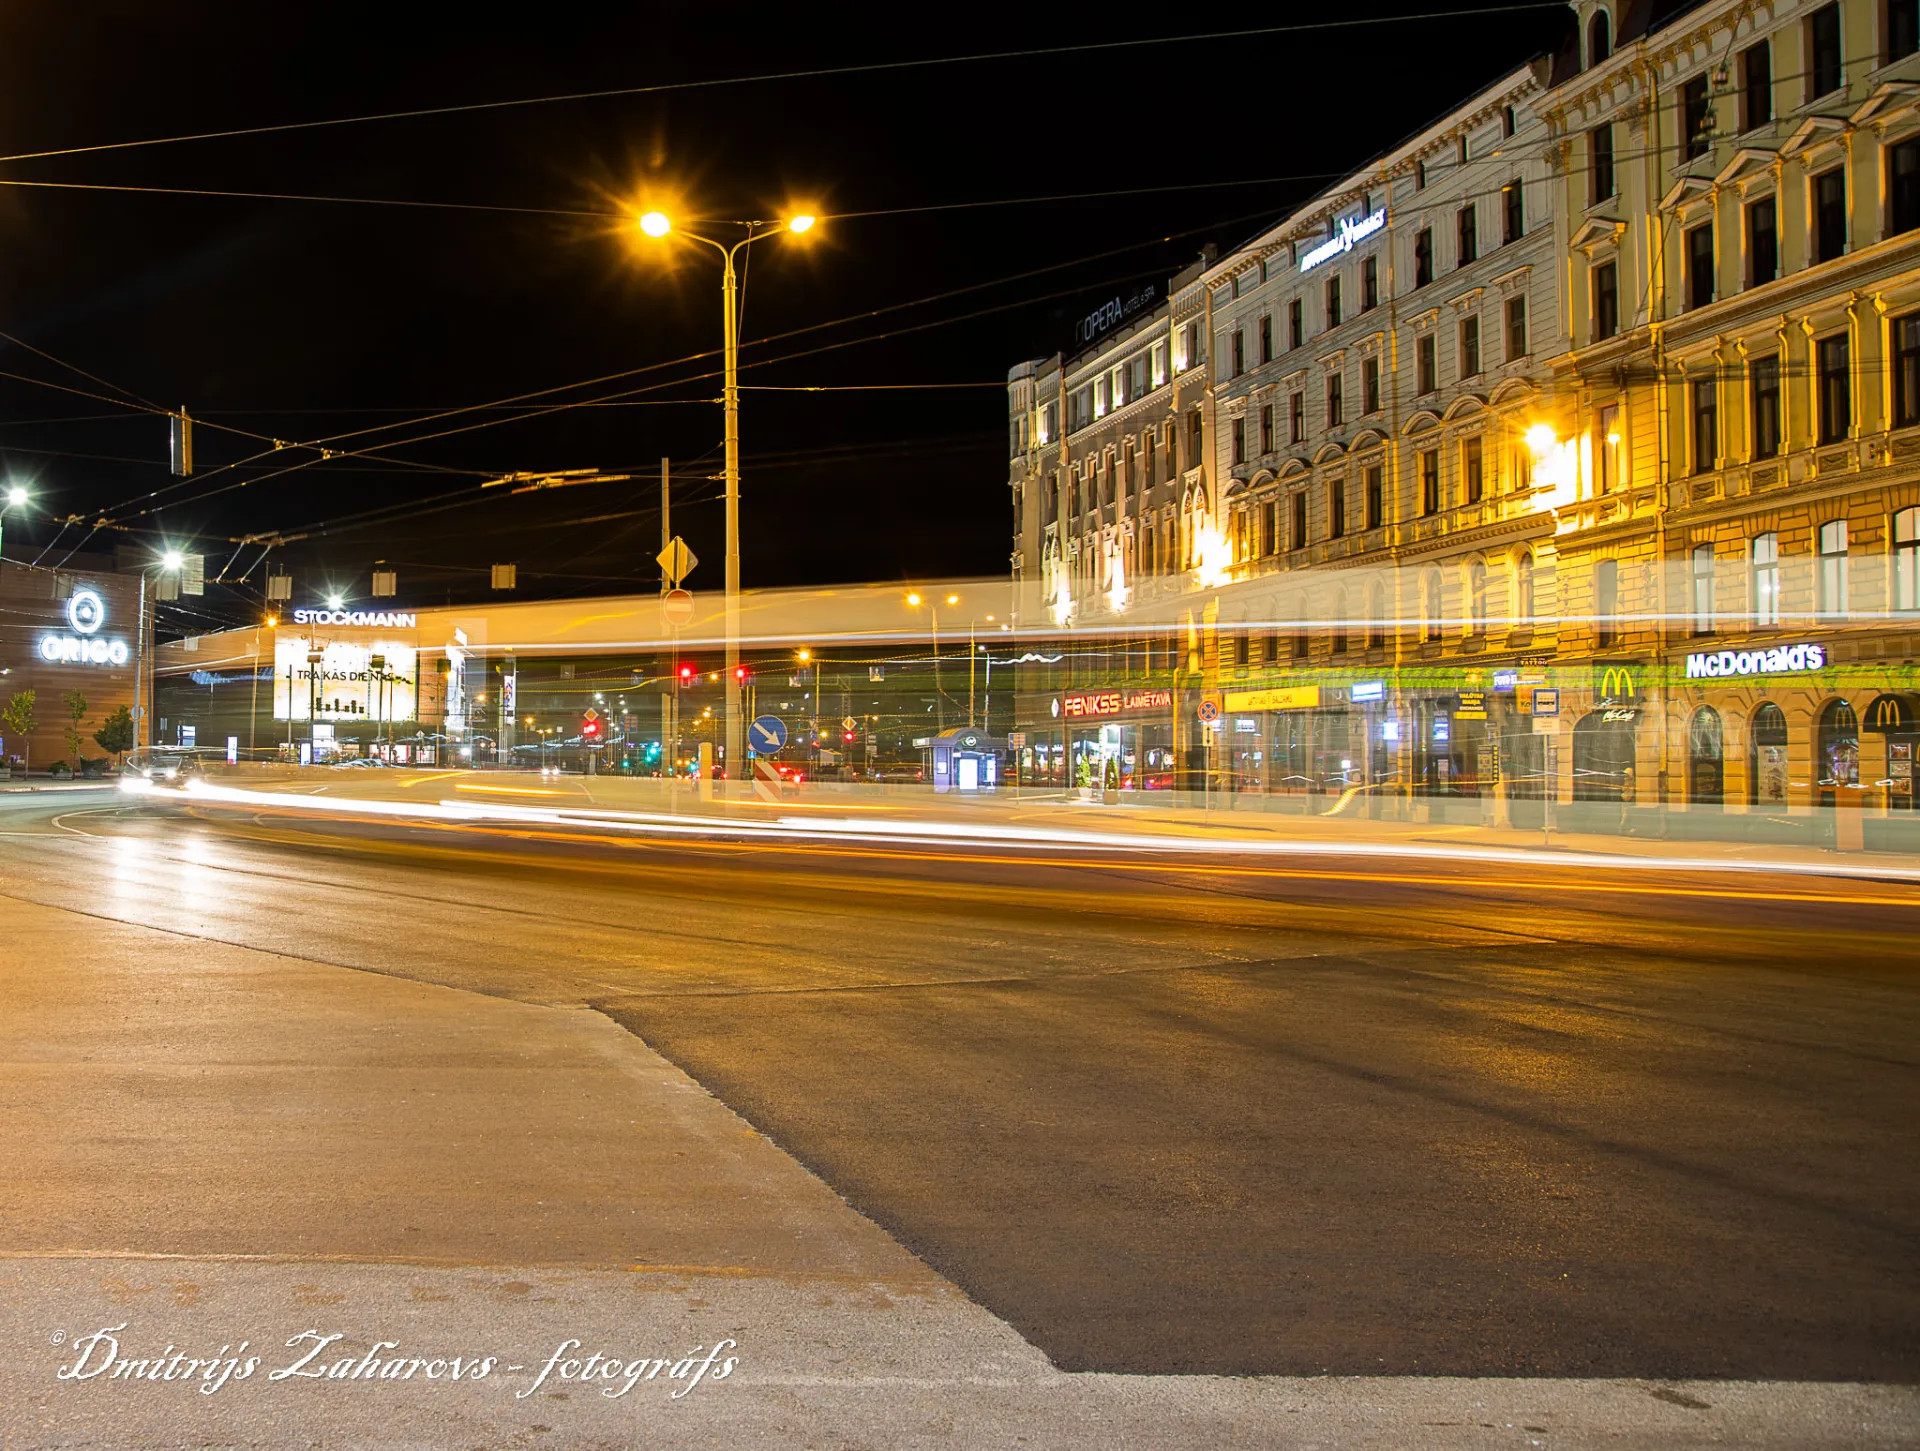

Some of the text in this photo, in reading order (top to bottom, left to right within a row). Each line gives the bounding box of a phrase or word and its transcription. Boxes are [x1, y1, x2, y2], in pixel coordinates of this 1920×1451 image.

[1084, 296, 1122, 340] OPERA
[1123, 296, 1140, 315] HOTEL
[294, 609, 416, 628] STOCKMANN
[40, 635, 128, 665] ORIGO
[1686, 644, 1824, 679] McDonald's
[1064, 694, 1122, 717] FENIKSS
